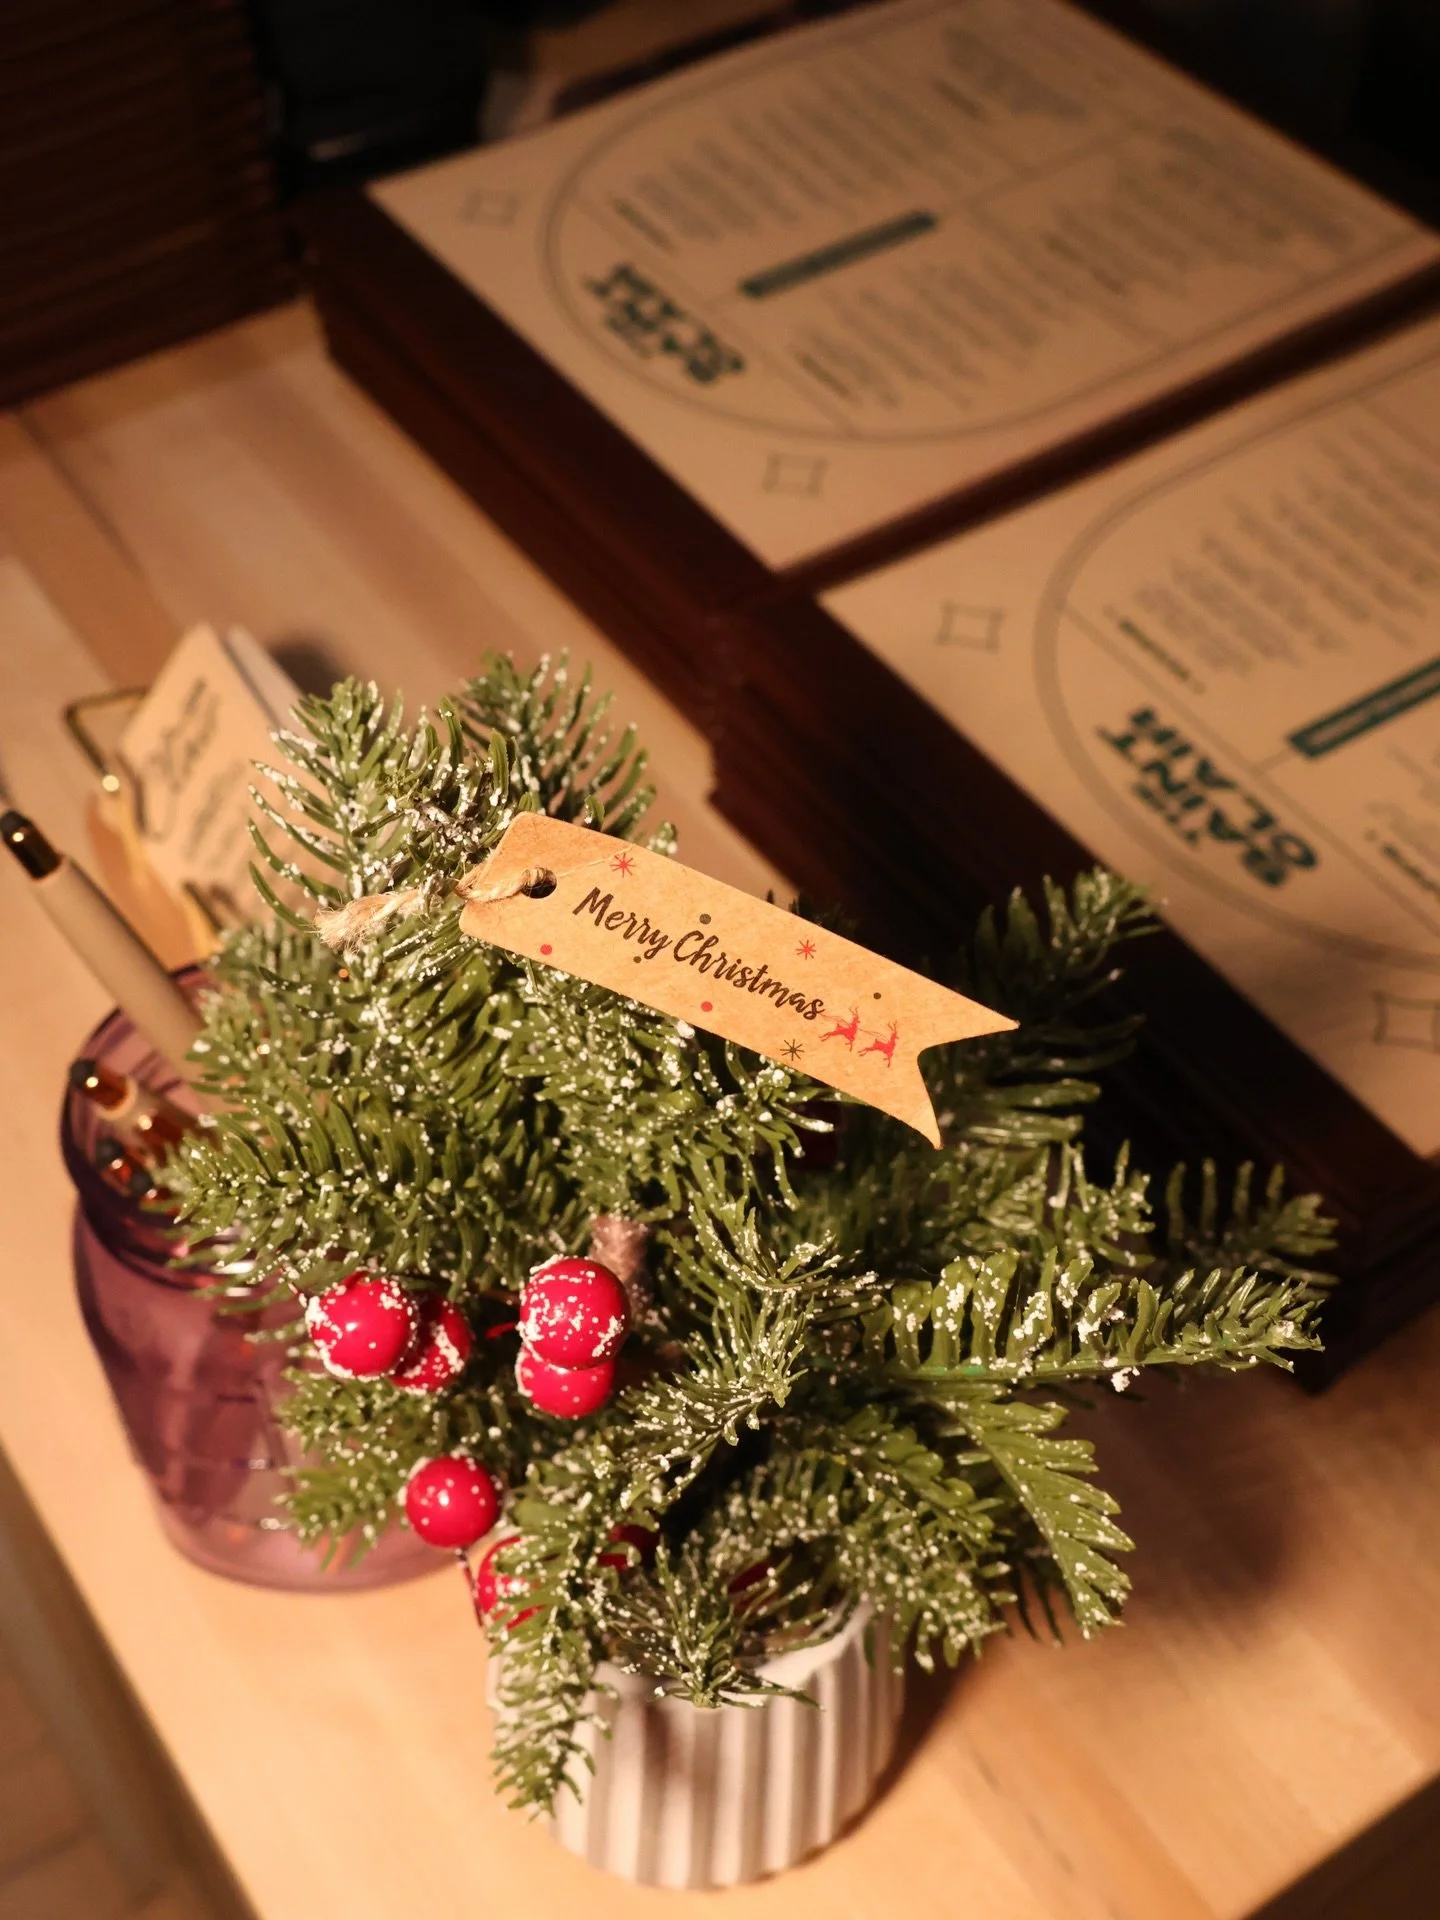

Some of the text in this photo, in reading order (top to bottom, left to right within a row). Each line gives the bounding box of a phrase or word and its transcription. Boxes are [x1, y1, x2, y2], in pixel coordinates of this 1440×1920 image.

[1096, 725, 1288, 888] SAINT
[572, 887, 826, 1021] Merry Christmas
